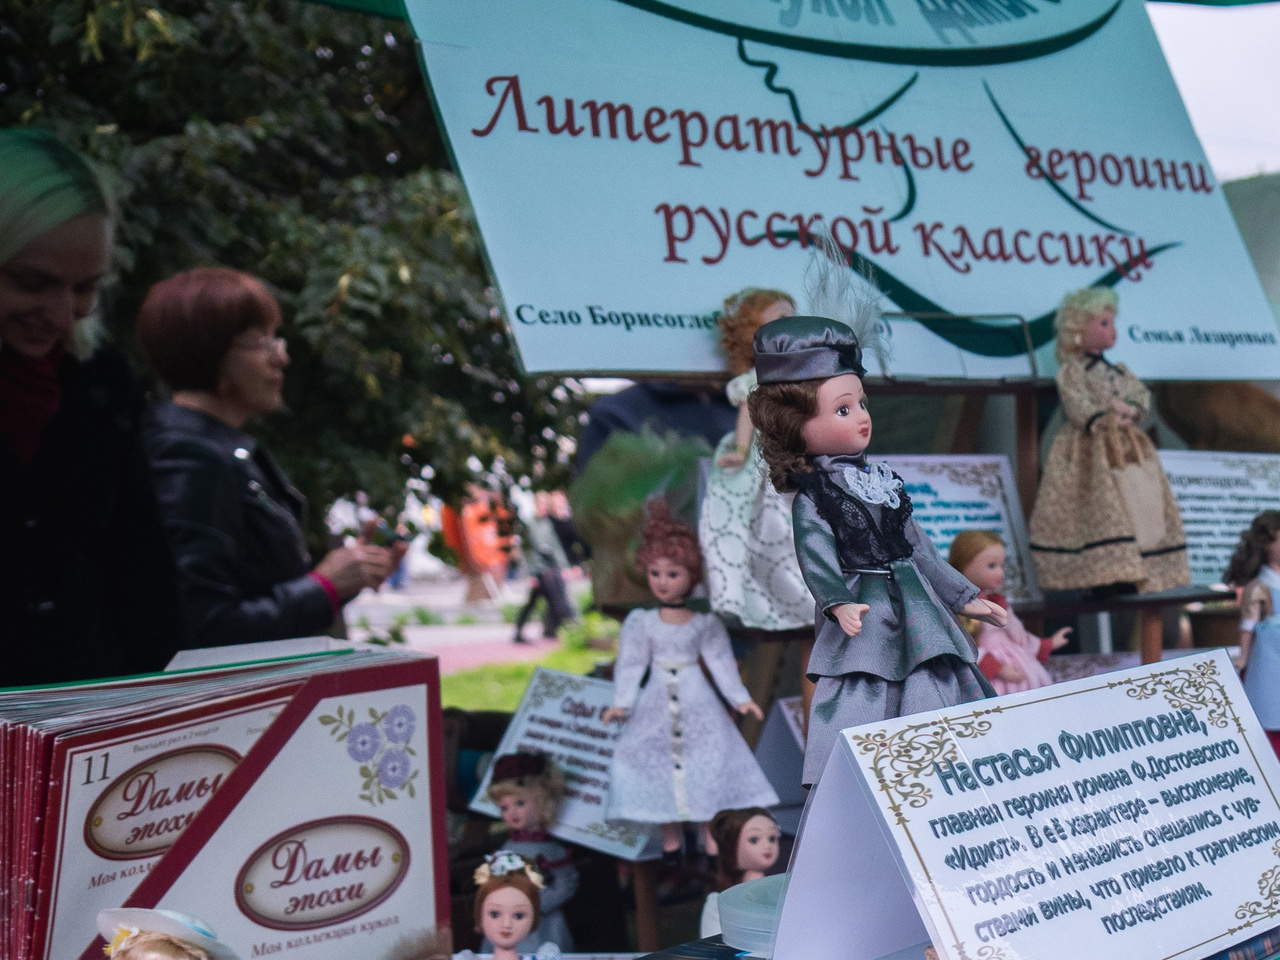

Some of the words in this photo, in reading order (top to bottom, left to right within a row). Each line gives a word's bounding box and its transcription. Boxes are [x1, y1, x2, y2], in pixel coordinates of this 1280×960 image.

[471, 74, 975, 179] Литературные
[1023, 140, 1216, 200] героини
[654, 200, 899, 265] русской
[915, 220, 1155, 283] классики
[515, 303, 582, 326] Село
[586, 304, 722, 332] Борисогле
[1128, 324, 1184, 345] Семья
[81, 752, 111, 786] 11
[929, 741, 1061, 795] Настасья
[1057, 707, 1209, 763] Филипповна,
[116, 769, 224, 821] Дамы
[927, 802, 1005, 839] главная
[1001, 784, 1074, 819] героиня
[1071, 767, 1133, 804] романа
[1130, 738, 1240, 782] Ф.Достоевского
[1023, 824, 1044, 849] В
[1041, 816, 1068, 844] её
[1064, 797, 1149, 837] характере
[1158, 766, 1256, 808] высокомерие,
[119, 862, 154, 879] колл
[269, 838, 383, 889] Дамы
[965, 866, 1046, 905] гордость
[1044, 860, 1062, 881] и
[1058, 835, 1144, 875] ненависть
[1142, 808, 1223, 848] смешались
[1220, 803, 1234, 821] с
[1230, 796, 1261, 820] чув-
[283, 881, 366, 915] эпохи
[974, 906, 1040, 942] ствами
[1037, 888, 1092, 921] вины,
[1088, 876, 1122, 900] что
[1183, 849, 1200, 868] к
[1099, 880, 1212, 935] последствиям.
[250, 941, 283, 957] Моя
[286, 924, 357, 949] коллекция
[359, 914, 401, 935] кукол
